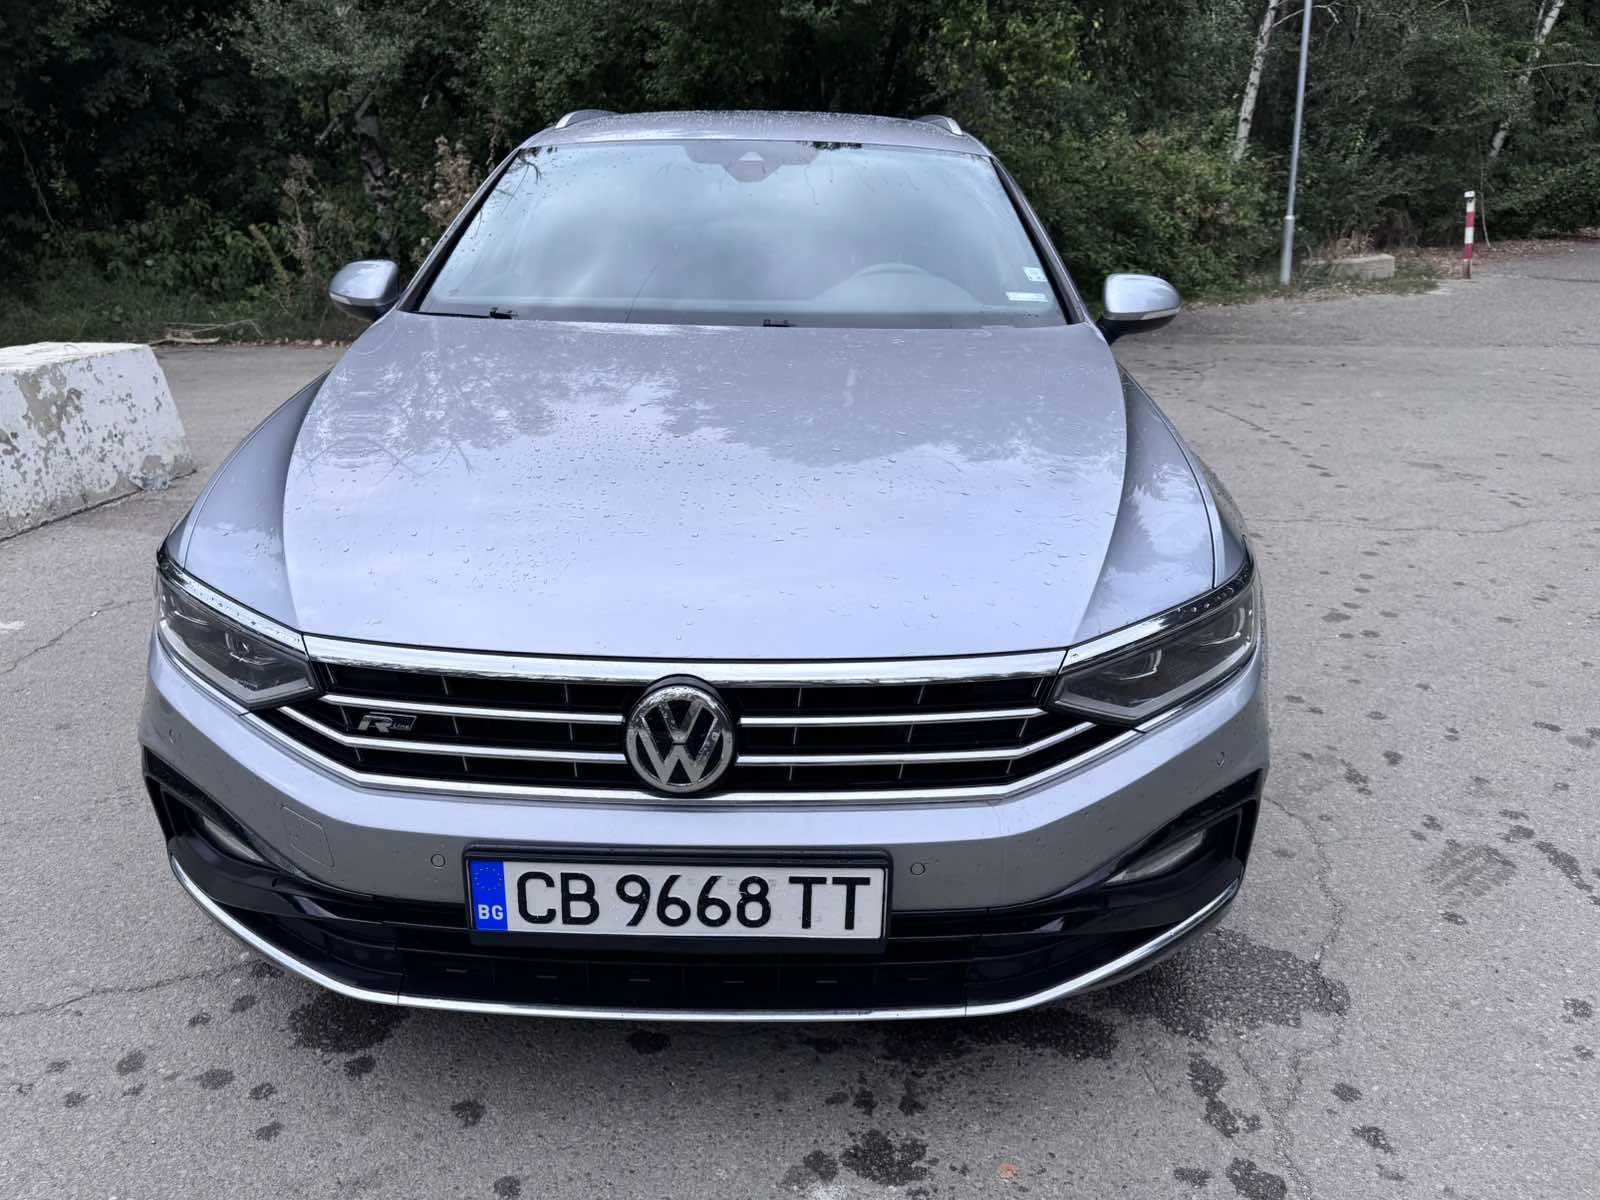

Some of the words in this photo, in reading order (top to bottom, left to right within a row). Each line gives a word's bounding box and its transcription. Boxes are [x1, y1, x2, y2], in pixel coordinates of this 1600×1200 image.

[638, 697, 719, 785] VW
[477, 904, 504, 920] BG
[517, 871, 600, 925] CB
[615, 873, 772, 929] 9668
[789, 876, 871, 930] TT
